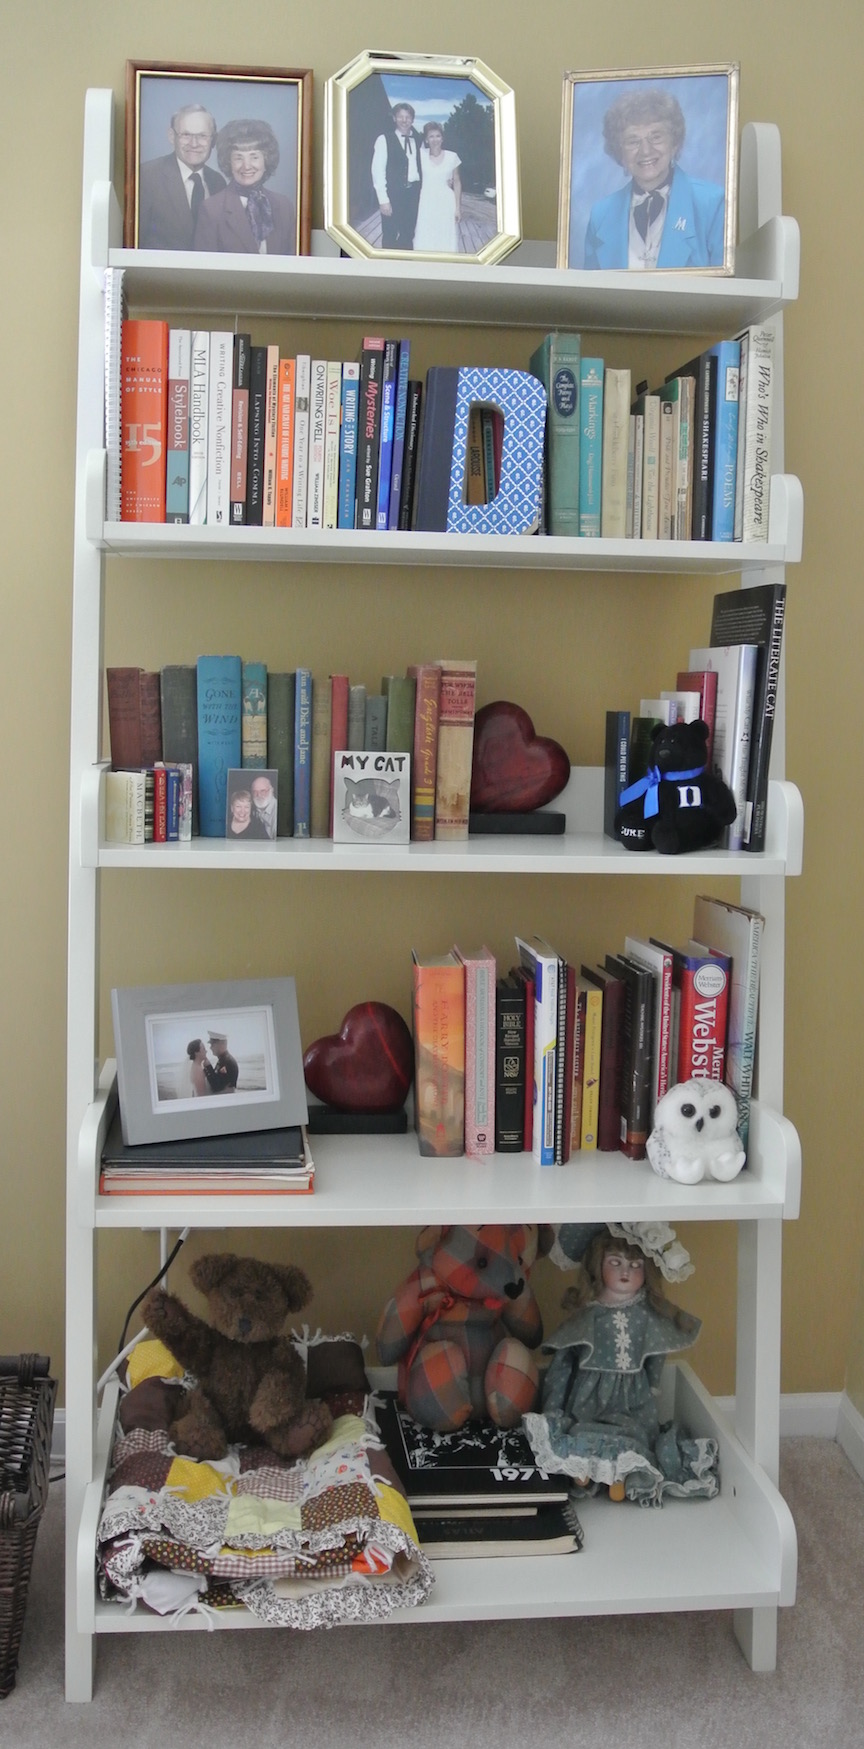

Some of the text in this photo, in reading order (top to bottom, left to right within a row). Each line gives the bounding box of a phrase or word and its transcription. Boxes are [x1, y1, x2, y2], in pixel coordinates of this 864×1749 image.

[194, 350, 206, 378] MLA
[192, 384, 206, 444] Handbook
[216, 382, 226, 422] Creative
[254, 394, 262, 434] LAPSING
[314, 365, 325, 442] ON WRITING WELL
[328, 380, 338, 408] Woe
[365, 381, 378, 438] Mysteries
[396, 352, 408, 440] CREATIVE NONFICTION
[171, 385, 188, 448] Stylebook
[328, 414, 337, 425] Is
[344, 390, 356, 454] WRITING STORY
[584, 394, 598, 440] Markings
[125, 422, 162, 468] 15
[215, 425, 225, 474] Nonfiction
[470, 446, 481, 476] LAROUSSE
[749, 365, 771, 524] Who's Who in Shakespeare
[252, 468, 260, 505] COMMA
[723, 464, 733, 507] POEMS
[301, 671, 309, 686] Fun
[765, 598, 785, 720] THE LITERATE CAT
[205, 688, 233, 702] GONE
[203, 714, 238, 724] WIND
[299, 729, 308, 744] and
[300, 707, 309, 726] Dick
[420, 699, 437, 743] English
[298, 745, 308, 764] Jane
[341, 756, 406, 772] MY CAT
[751, 920, 760, 957] AMERICA
[441, 1000, 449, 1052] HARRY
[744, 1031, 754, 1060] WALT
[490, 1468, 550, 1481] 1971
